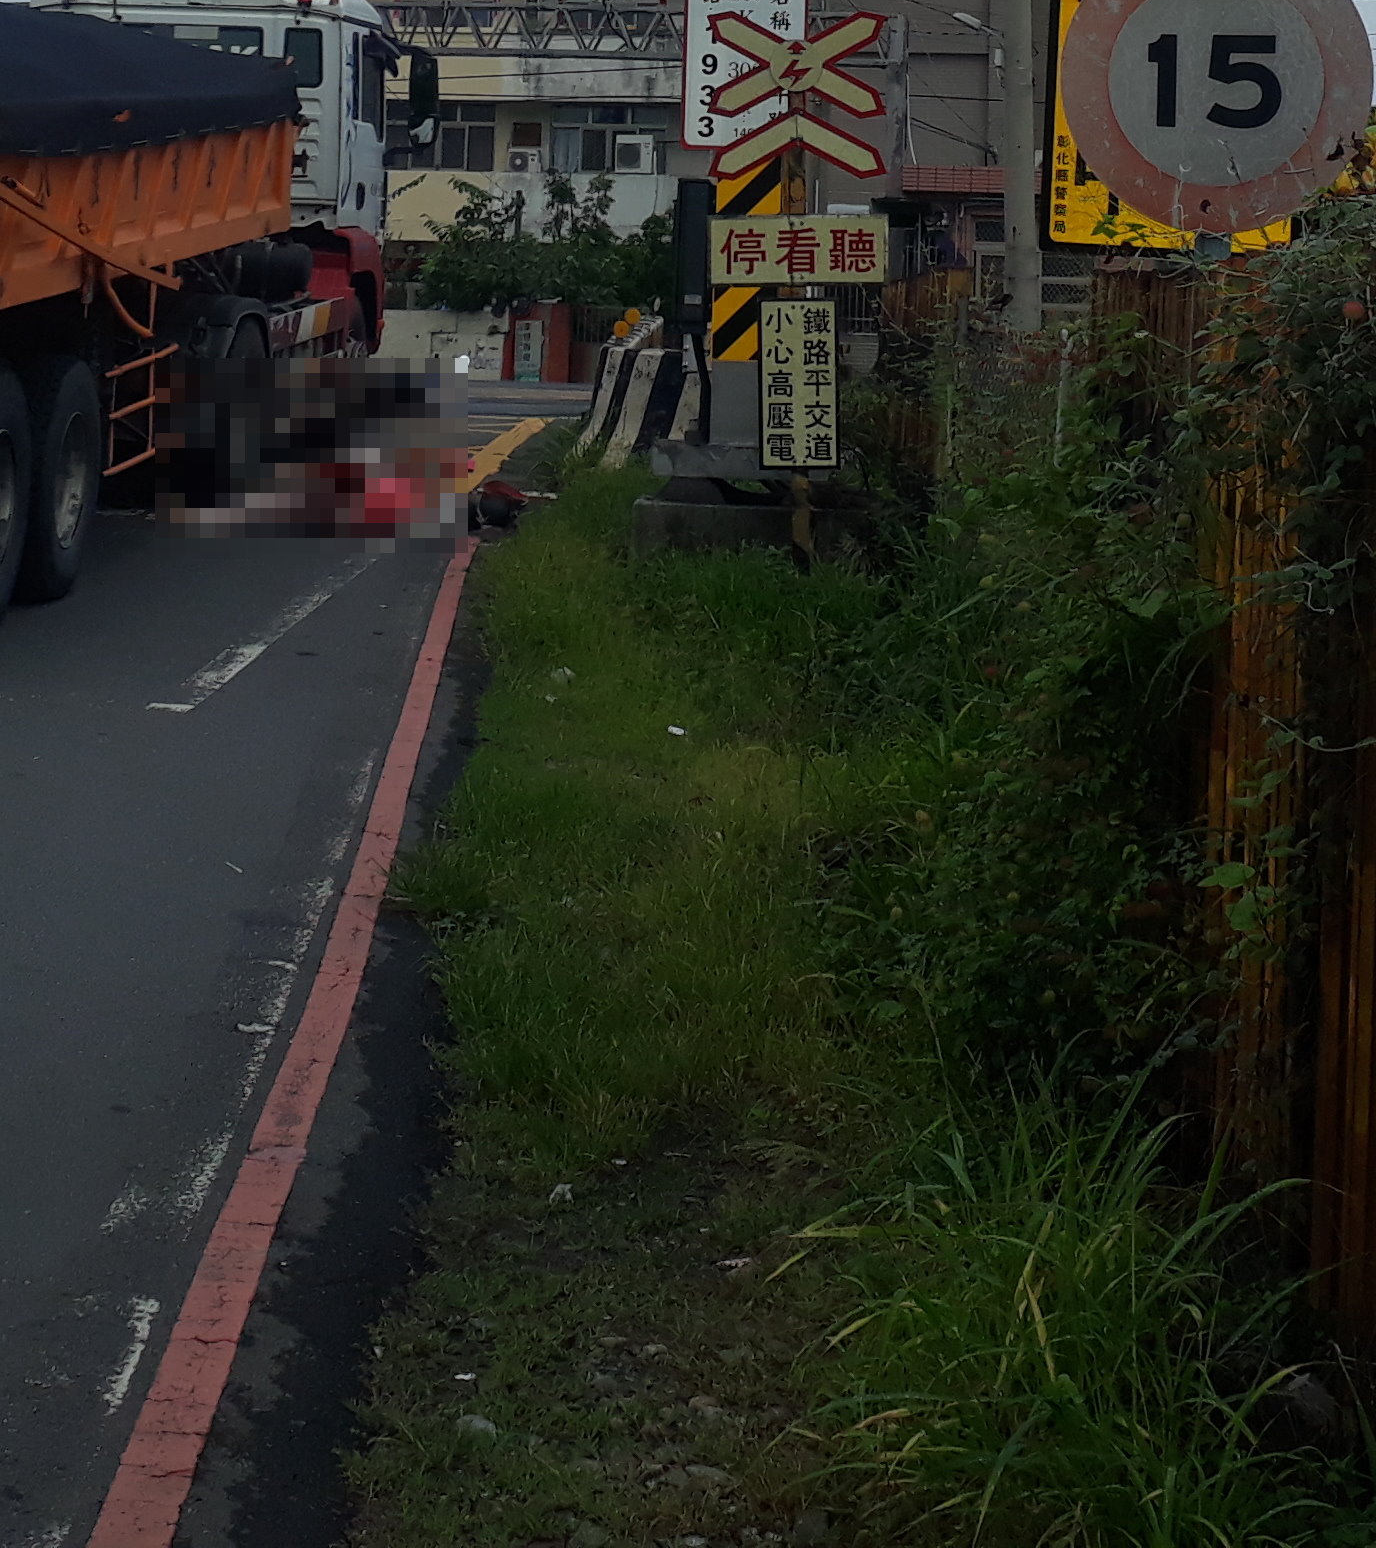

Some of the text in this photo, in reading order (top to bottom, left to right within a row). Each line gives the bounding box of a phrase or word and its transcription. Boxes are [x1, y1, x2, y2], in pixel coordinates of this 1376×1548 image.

[1148, 33, 1282, 129] 15
[720, 227, 877, 276] 停看聽
[765, 307, 795, 462] 小心高壓電
[802, 307, 833, 462] 鐵路平交道
